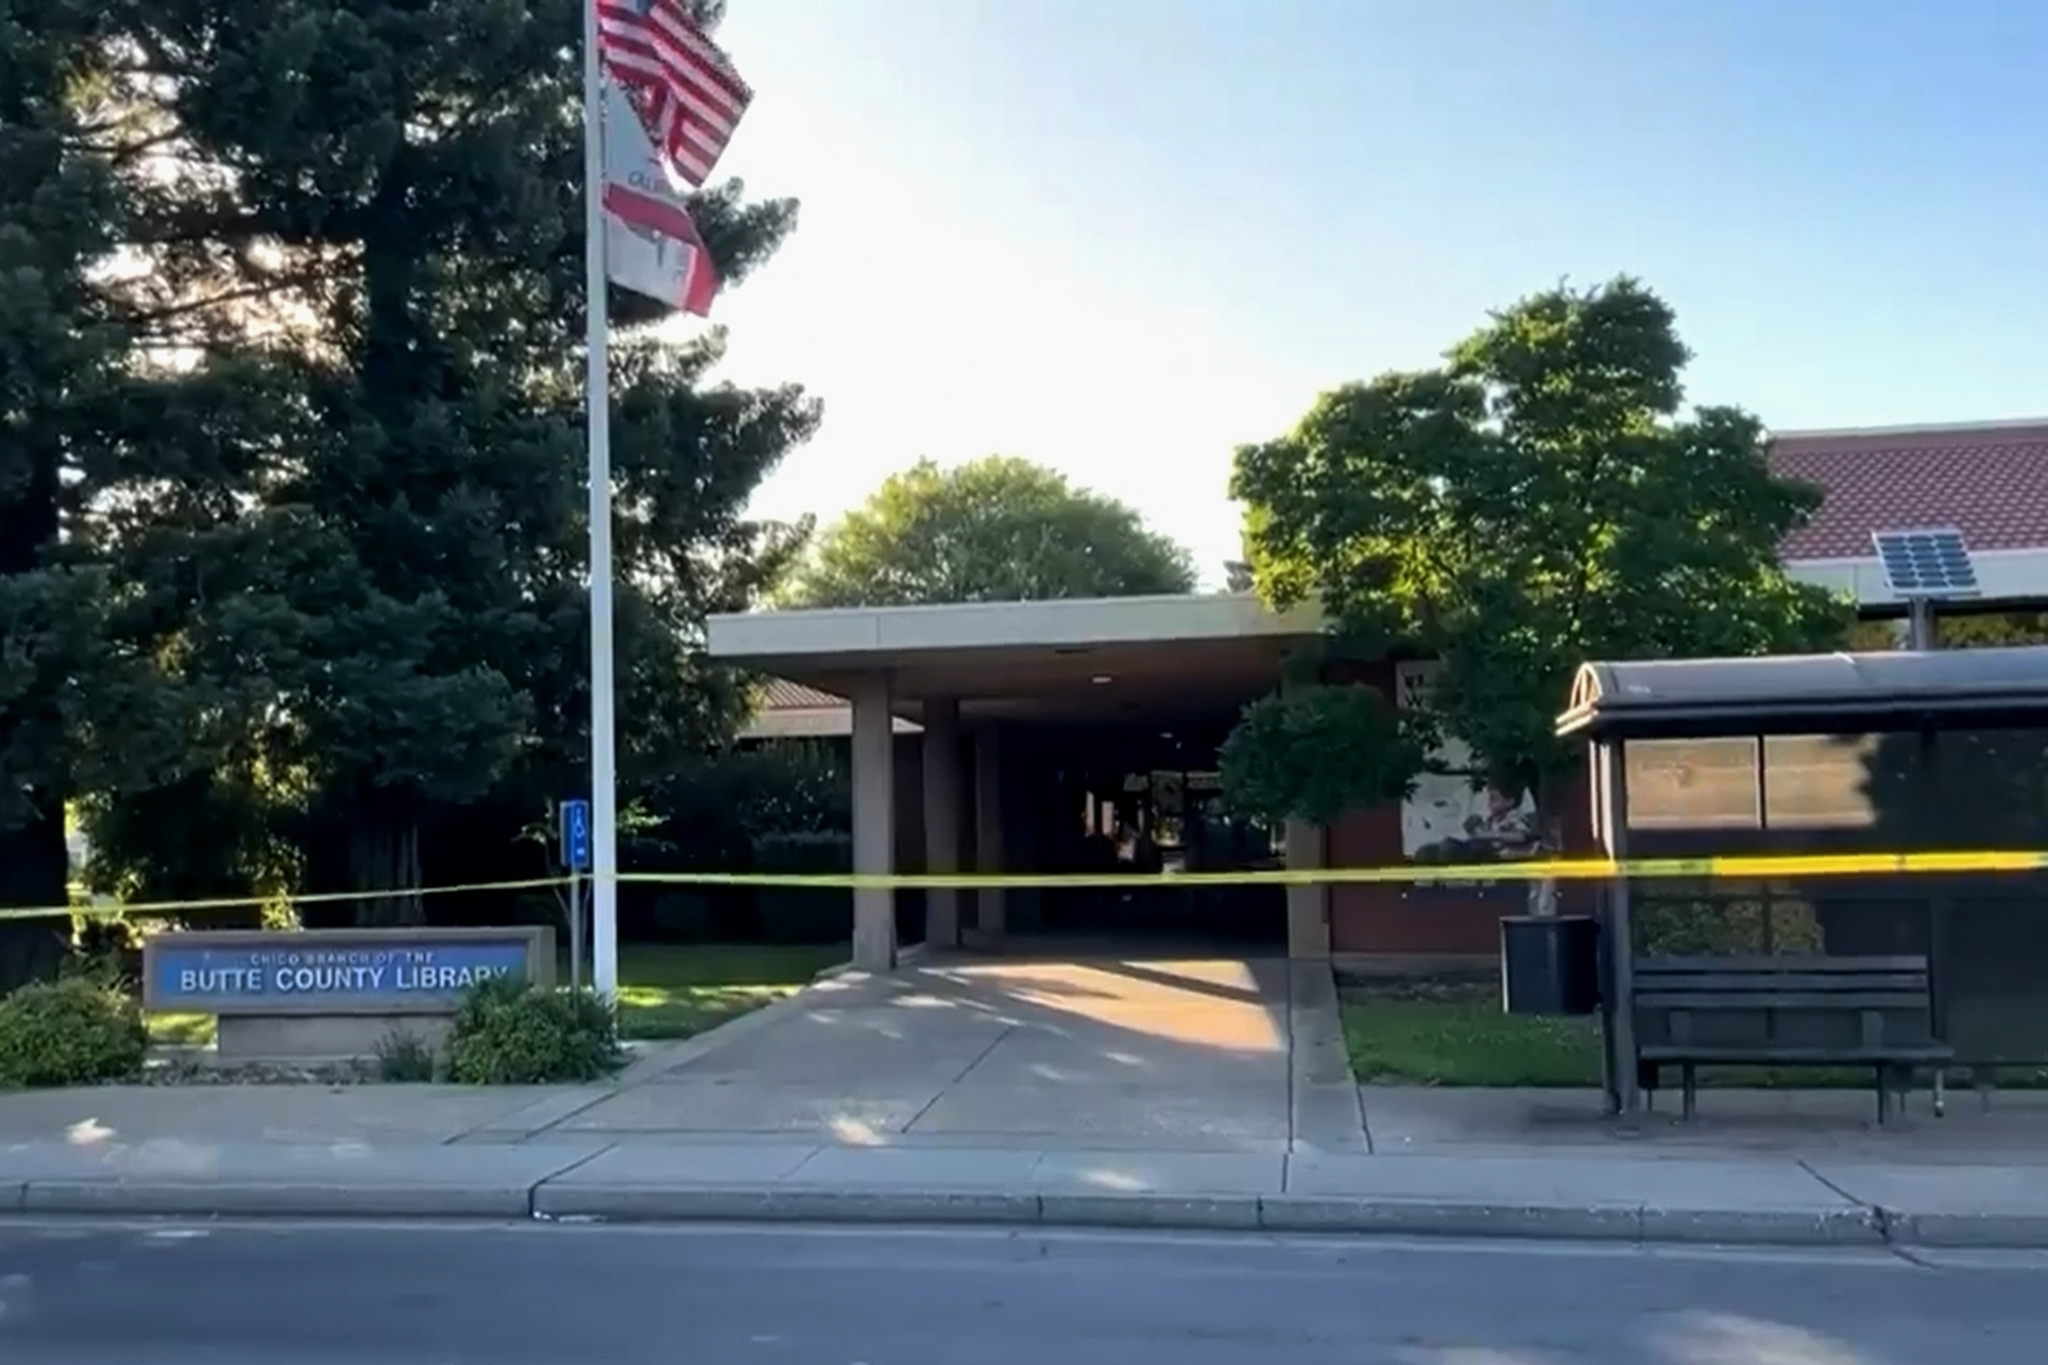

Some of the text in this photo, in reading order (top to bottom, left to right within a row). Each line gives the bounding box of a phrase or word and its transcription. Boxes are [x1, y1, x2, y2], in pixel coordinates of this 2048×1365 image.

[250, 953, 300, 966] CHICO
[405, 952, 434, 964] THE
[180, 968, 263, 992] BUTTE
[275, 967, 385, 990] COUNTY
